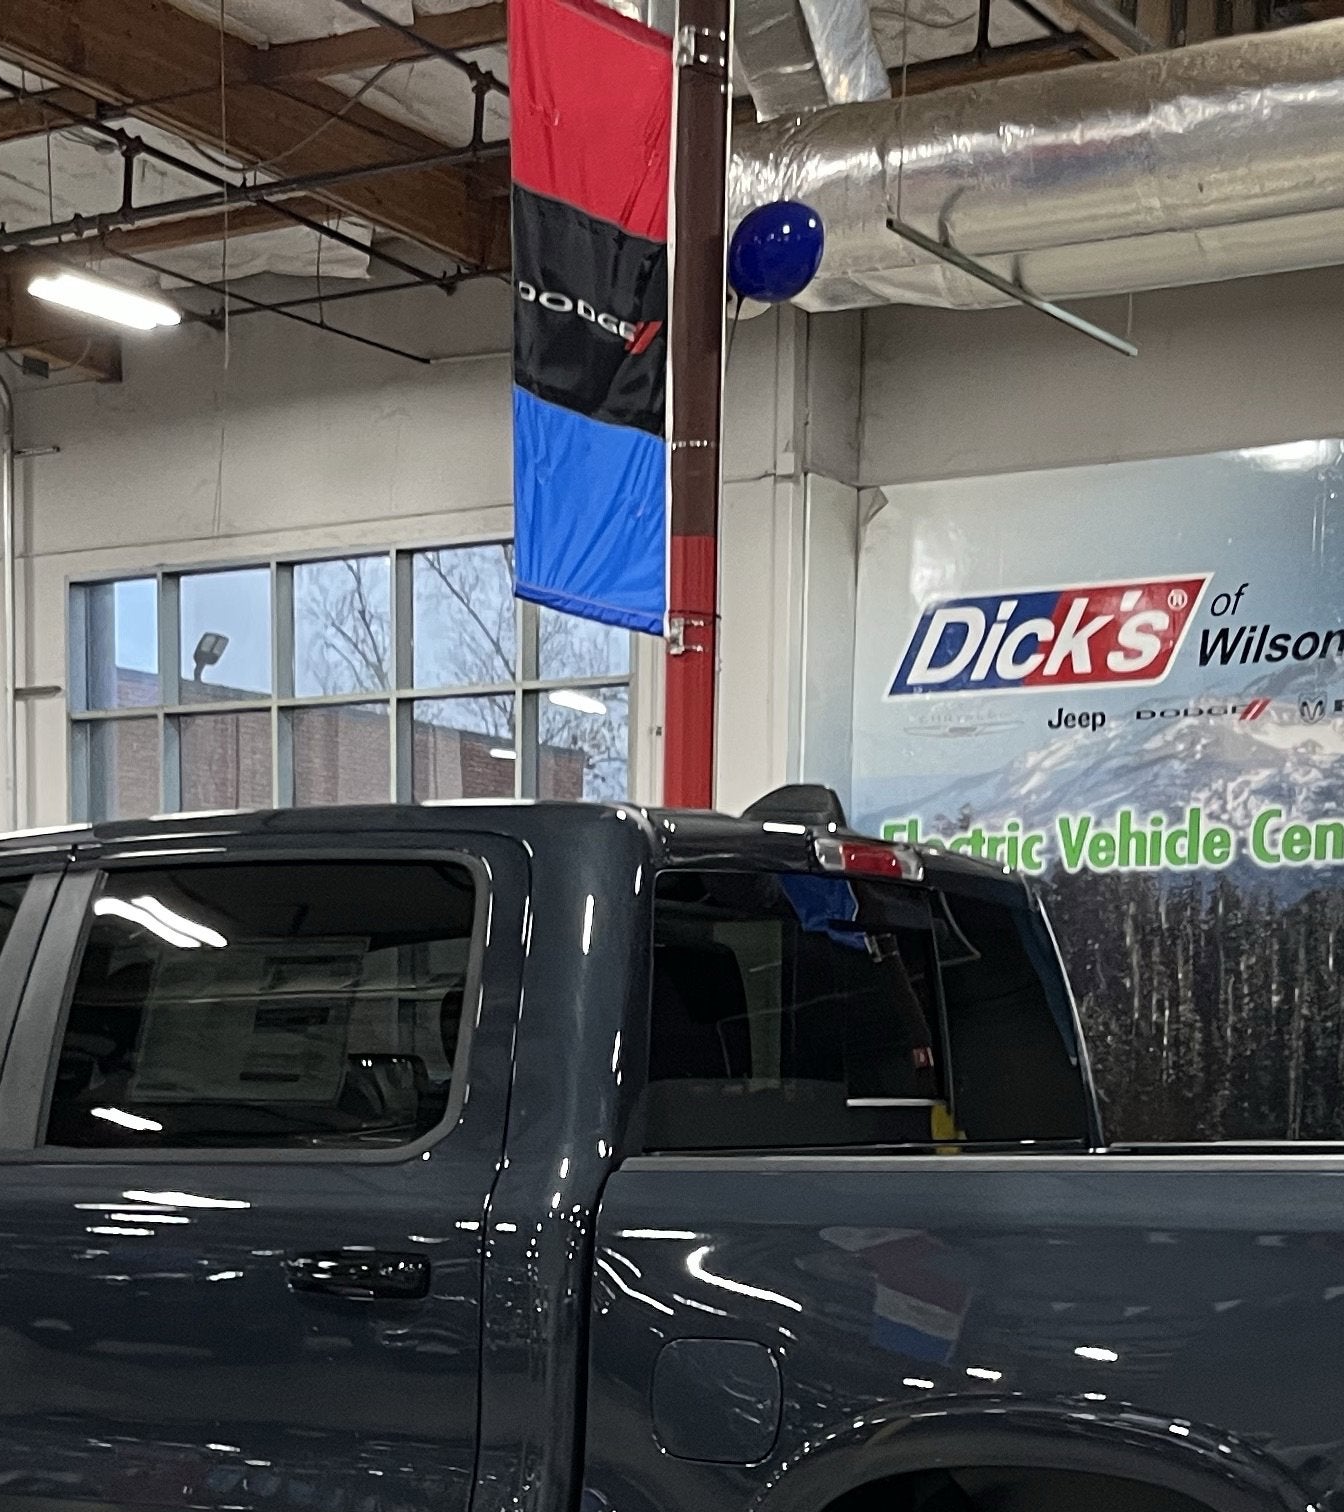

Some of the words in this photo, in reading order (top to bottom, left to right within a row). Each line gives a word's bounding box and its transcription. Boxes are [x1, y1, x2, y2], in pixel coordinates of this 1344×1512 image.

[519, 280, 636, 342] DODGE
[1210, 583, 1249, 616] of
[906, 590, 1170, 685] Dick's
[1047, 707, 1106, 732] Jeep
[1135, 704, 1247, 721] DODGE
[1058, 807, 1231, 869] Vehicle
